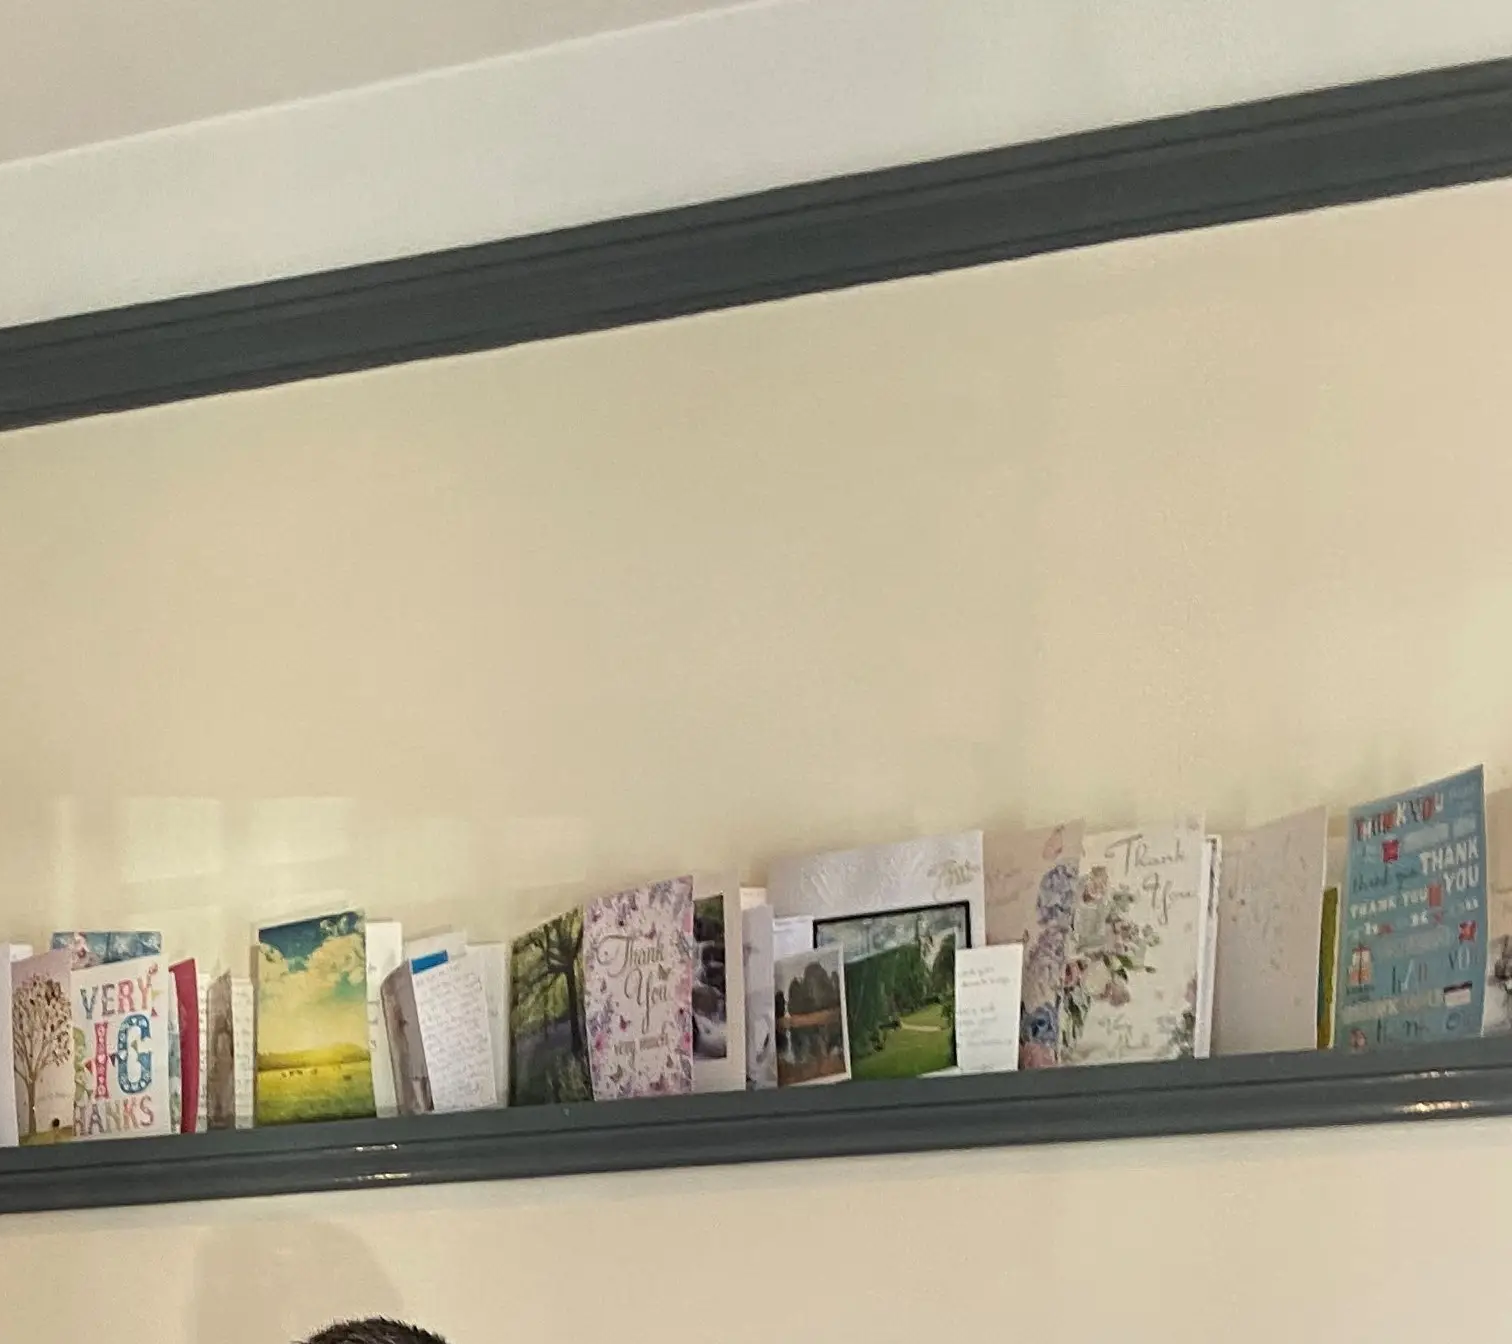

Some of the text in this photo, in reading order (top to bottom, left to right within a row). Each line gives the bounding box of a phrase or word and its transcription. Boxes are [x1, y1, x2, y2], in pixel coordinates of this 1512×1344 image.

[1104, 833, 1186, 876] Thank
[1419, 837, 1479, 876] THANK
[1443, 865, 1480, 893] YOU
[596, 931, 665, 978] Thank
[79, 962, 160, 1020] VERY
[624, 968, 669, 1035] You
[72, 1095, 156, 1137] HANKS
